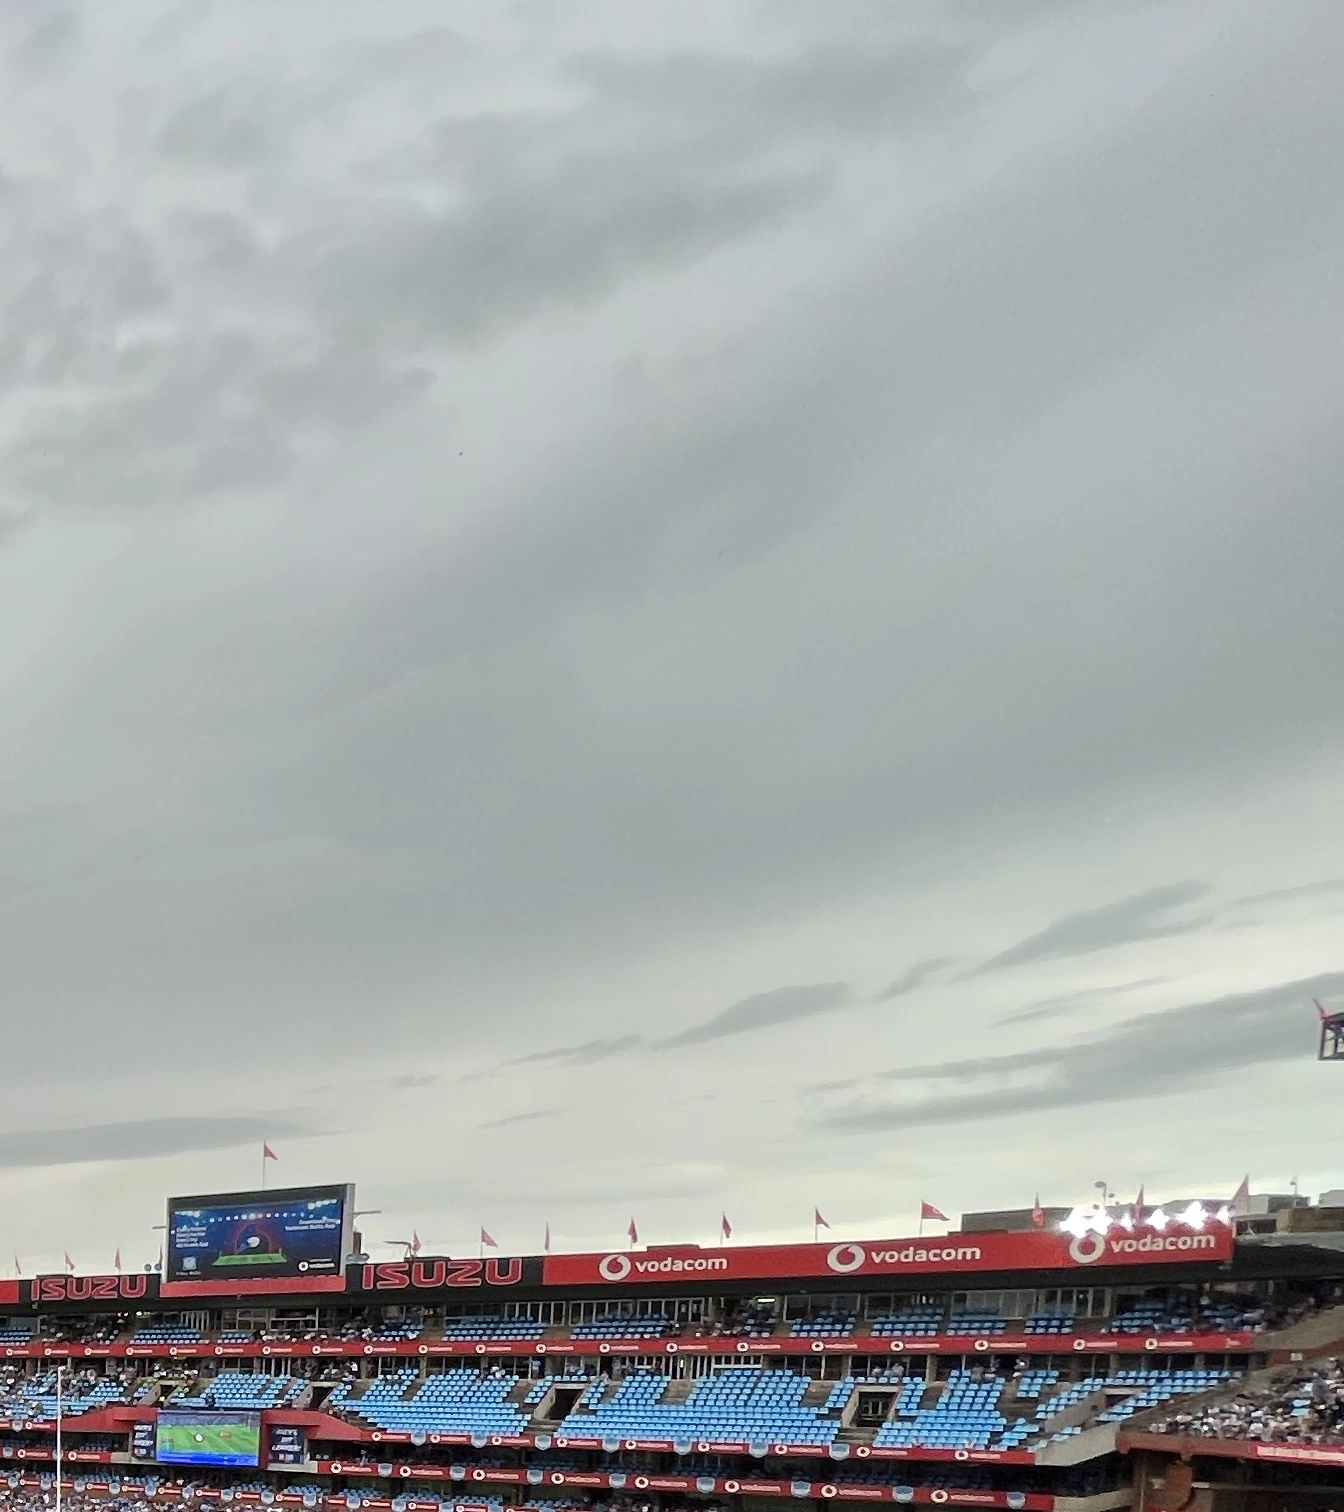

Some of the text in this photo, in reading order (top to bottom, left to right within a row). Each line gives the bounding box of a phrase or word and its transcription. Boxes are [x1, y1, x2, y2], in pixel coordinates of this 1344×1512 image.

[1111, 1232, 1216, 1254] vodacom
[635, 1256, 728, 1273] vodacom
[871, 1246, 981, 1263] vodacom
[362, 1258, 522, 1290] ISUZU
[31, 1275, 147, 1301] ISUZU
